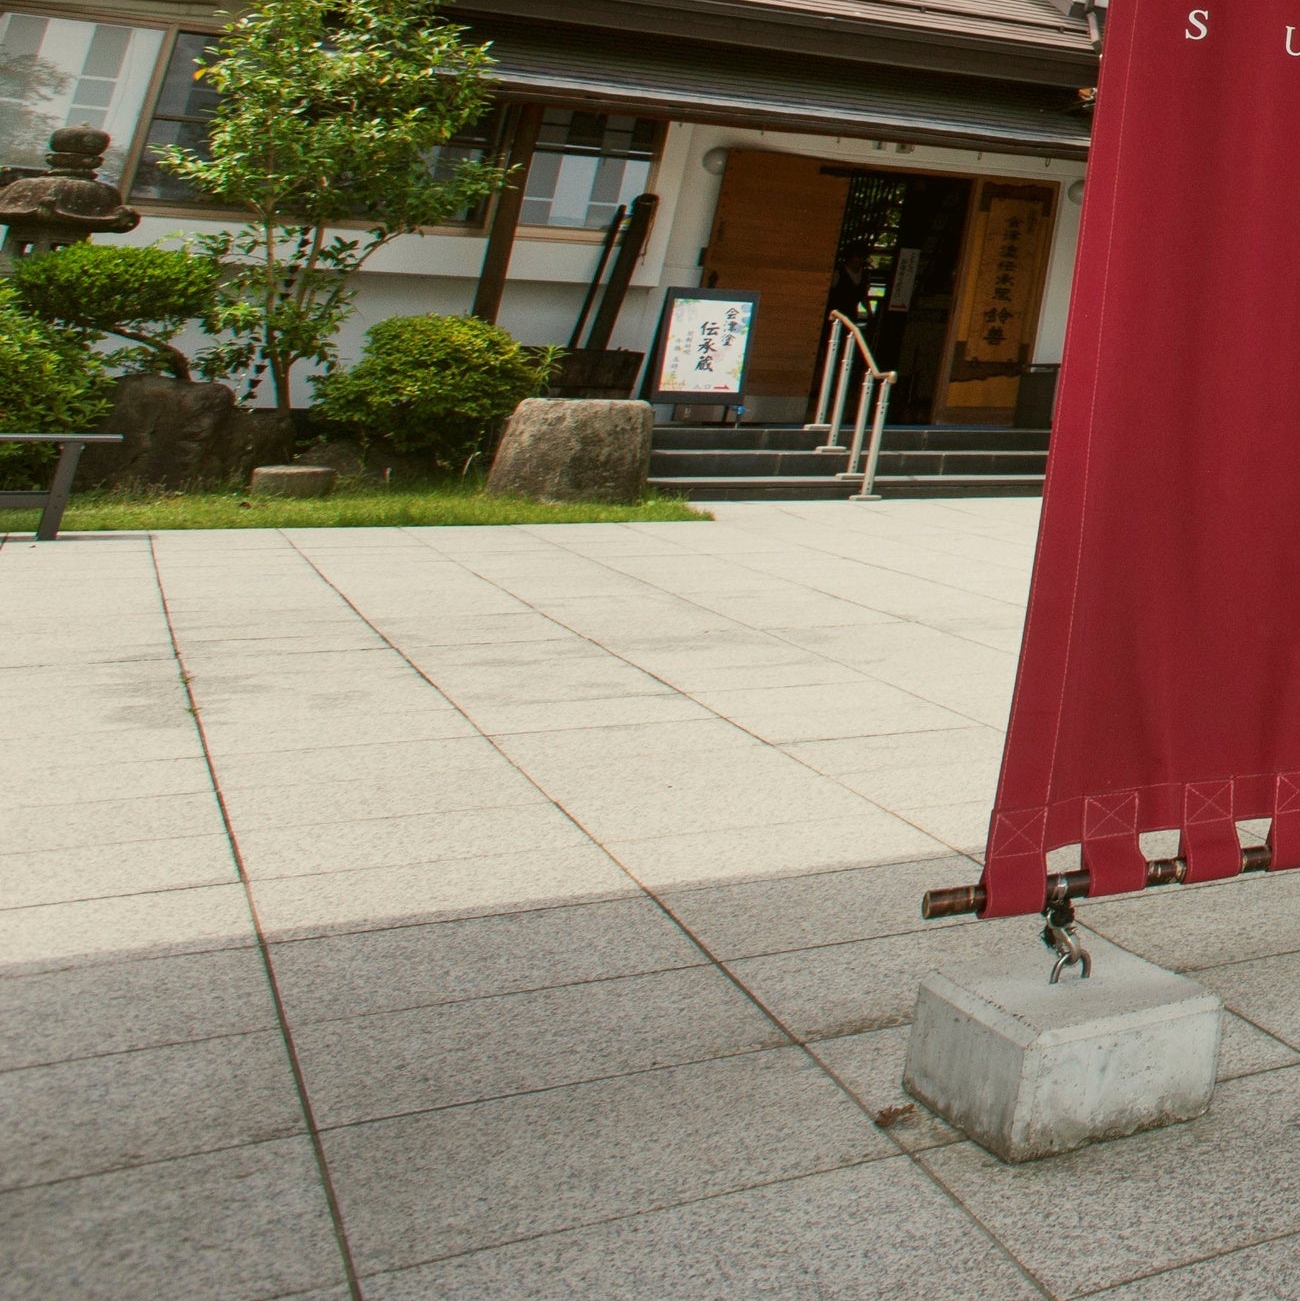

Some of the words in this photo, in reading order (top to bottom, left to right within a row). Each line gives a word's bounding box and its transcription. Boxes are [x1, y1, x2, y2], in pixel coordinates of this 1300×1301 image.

[695, 320, 720, 373] 伝承蔵
[721, 307, 740, 347] 会津塗
